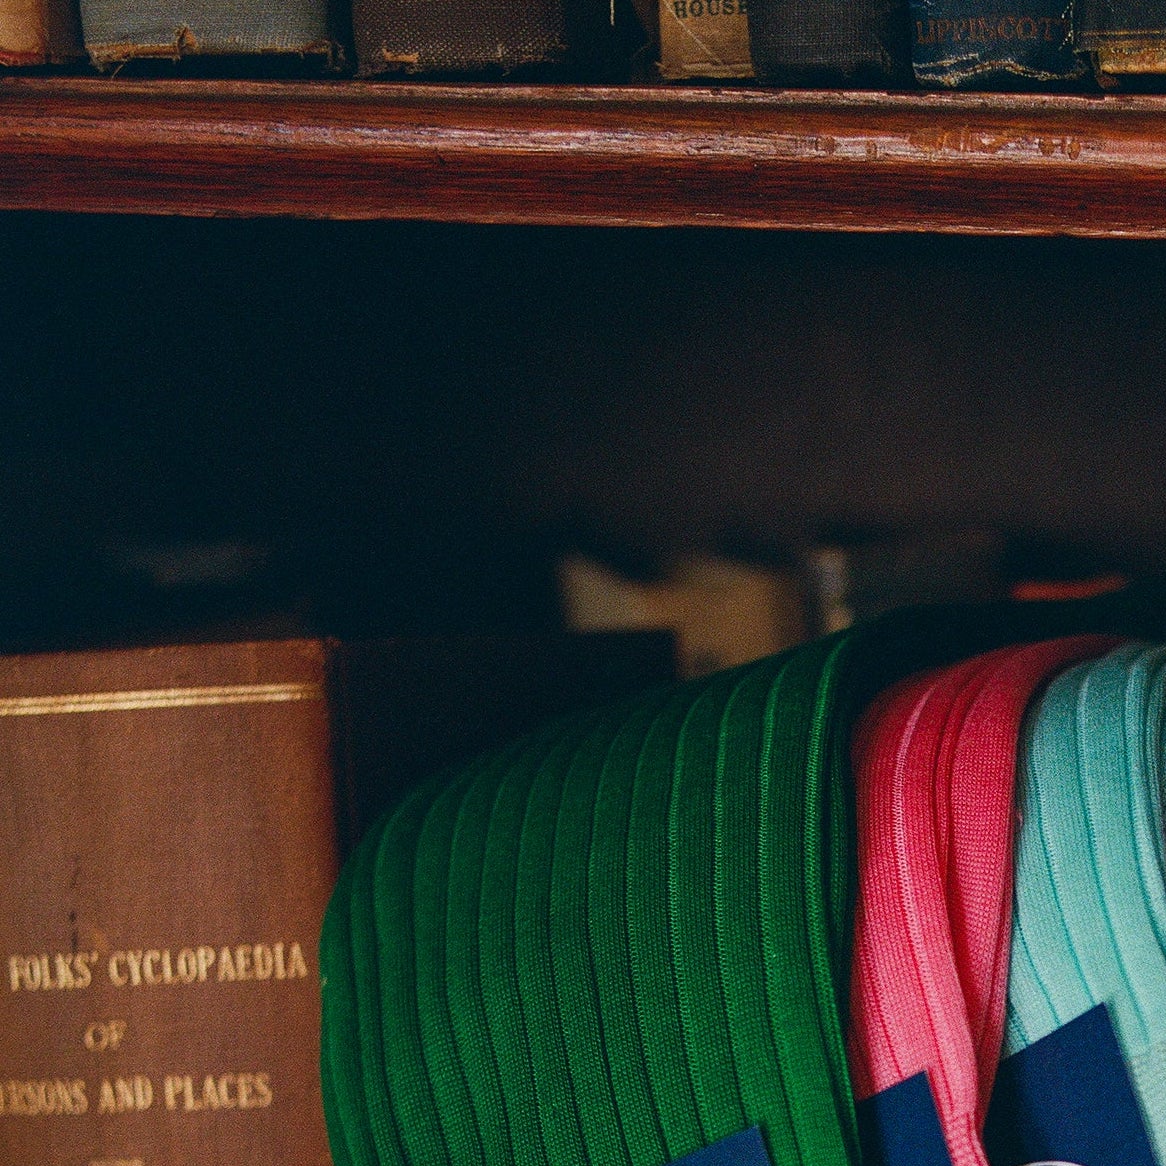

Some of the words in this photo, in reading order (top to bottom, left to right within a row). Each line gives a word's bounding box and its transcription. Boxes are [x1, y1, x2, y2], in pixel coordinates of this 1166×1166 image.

[107, 942, 308, 988] CYCLOPAEDIA
[84, 1019, 128, 1050] OF
[99, 1075, 152, 1115] AND
[164, 1071, 274, 1111] PLACES
